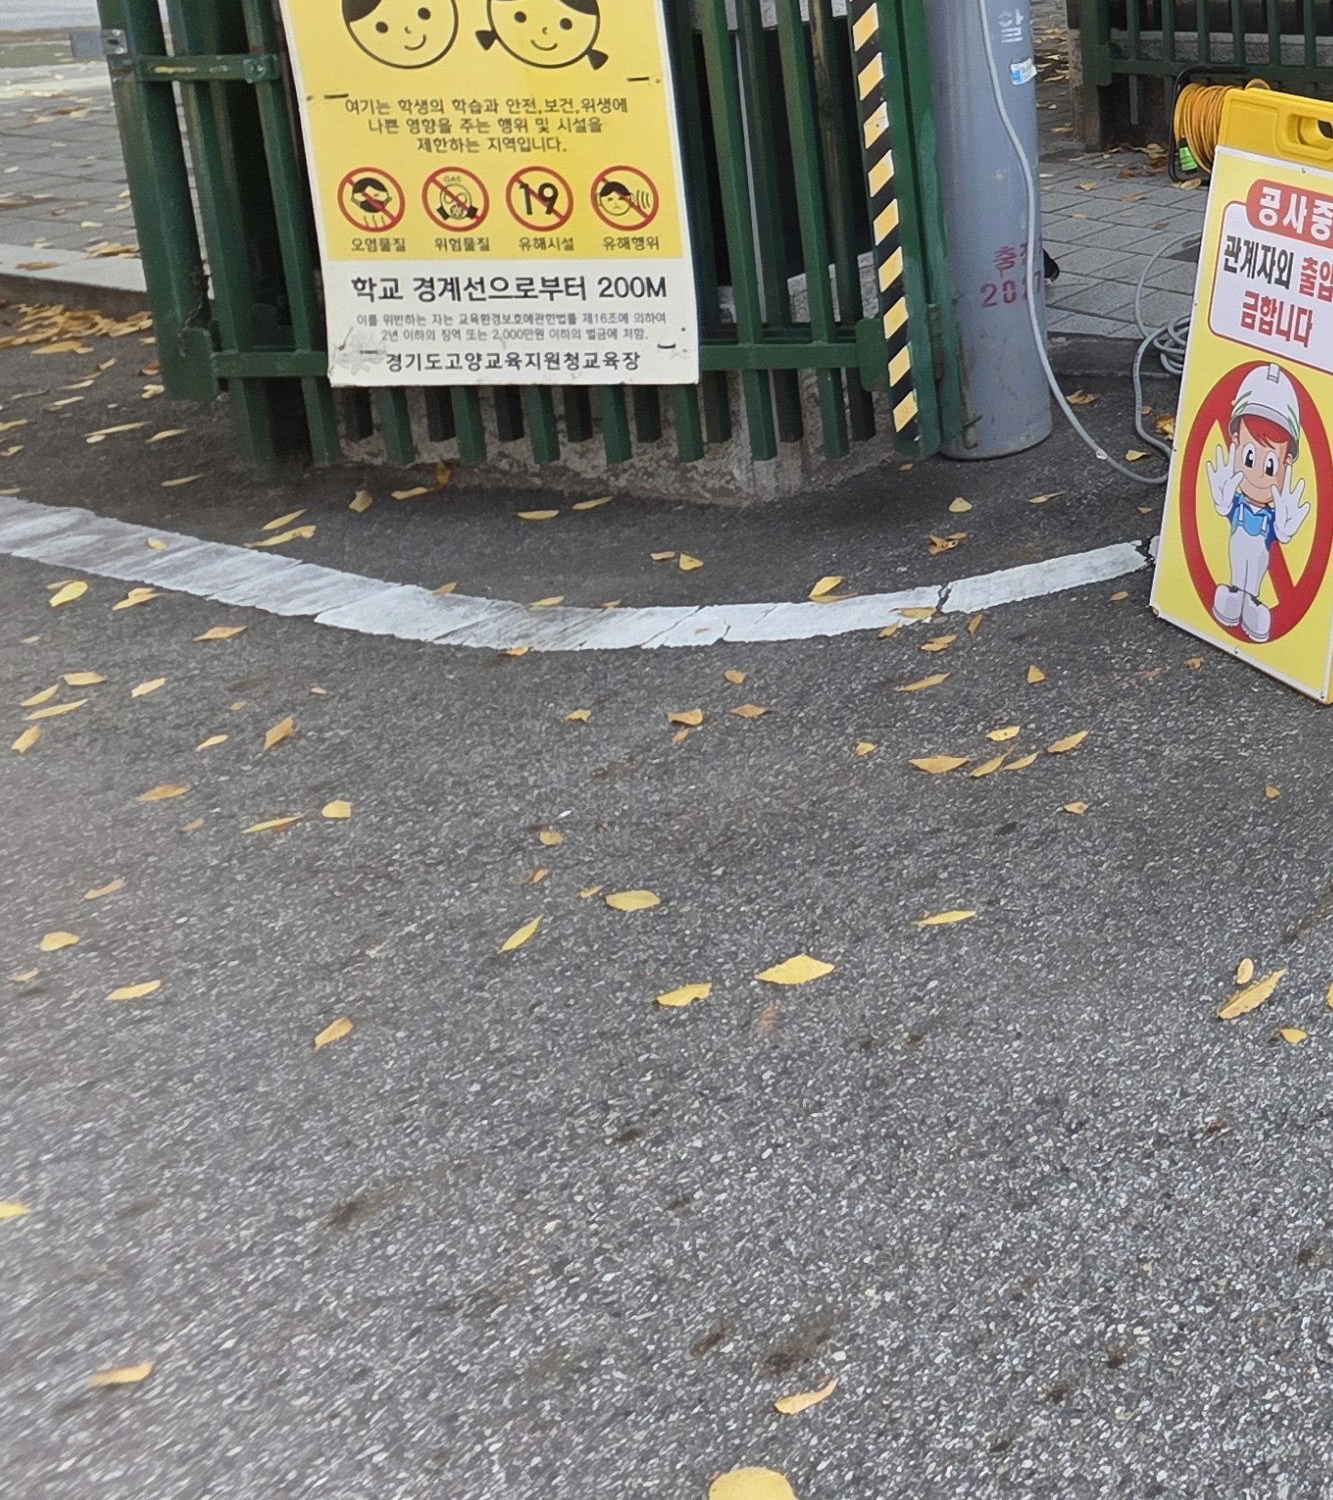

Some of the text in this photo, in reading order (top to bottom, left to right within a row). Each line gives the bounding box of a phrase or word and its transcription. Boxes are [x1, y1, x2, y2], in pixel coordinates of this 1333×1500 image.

[345, 98, 391, 116] 여기는
[397, 98, 445, 116] 학생의
[452, 98, 499, 116] 학습과
[368, 116, 603, 135] 나쁜 영향을 주는 행위 및 시설을
[416, 136, 568, 154] 제한하는 지역입니다.
[518, 182, 559, 215] 19
[1257, 186, 1333, 241] 공사중
[434, 236, 490, 252] 위험물질
[517, 236, 575, 252] 유해시설
[601, 235, 661, 252] 유해행위
[1222, 234, 1295, 291] 관계자외
[351, 275, 667, 303] 학교 경계선으로부터 200M
[1240, 291, 1314, 349] 금합니다
[386, 351, 641, 373] 경기도고양교육지원청교육장
